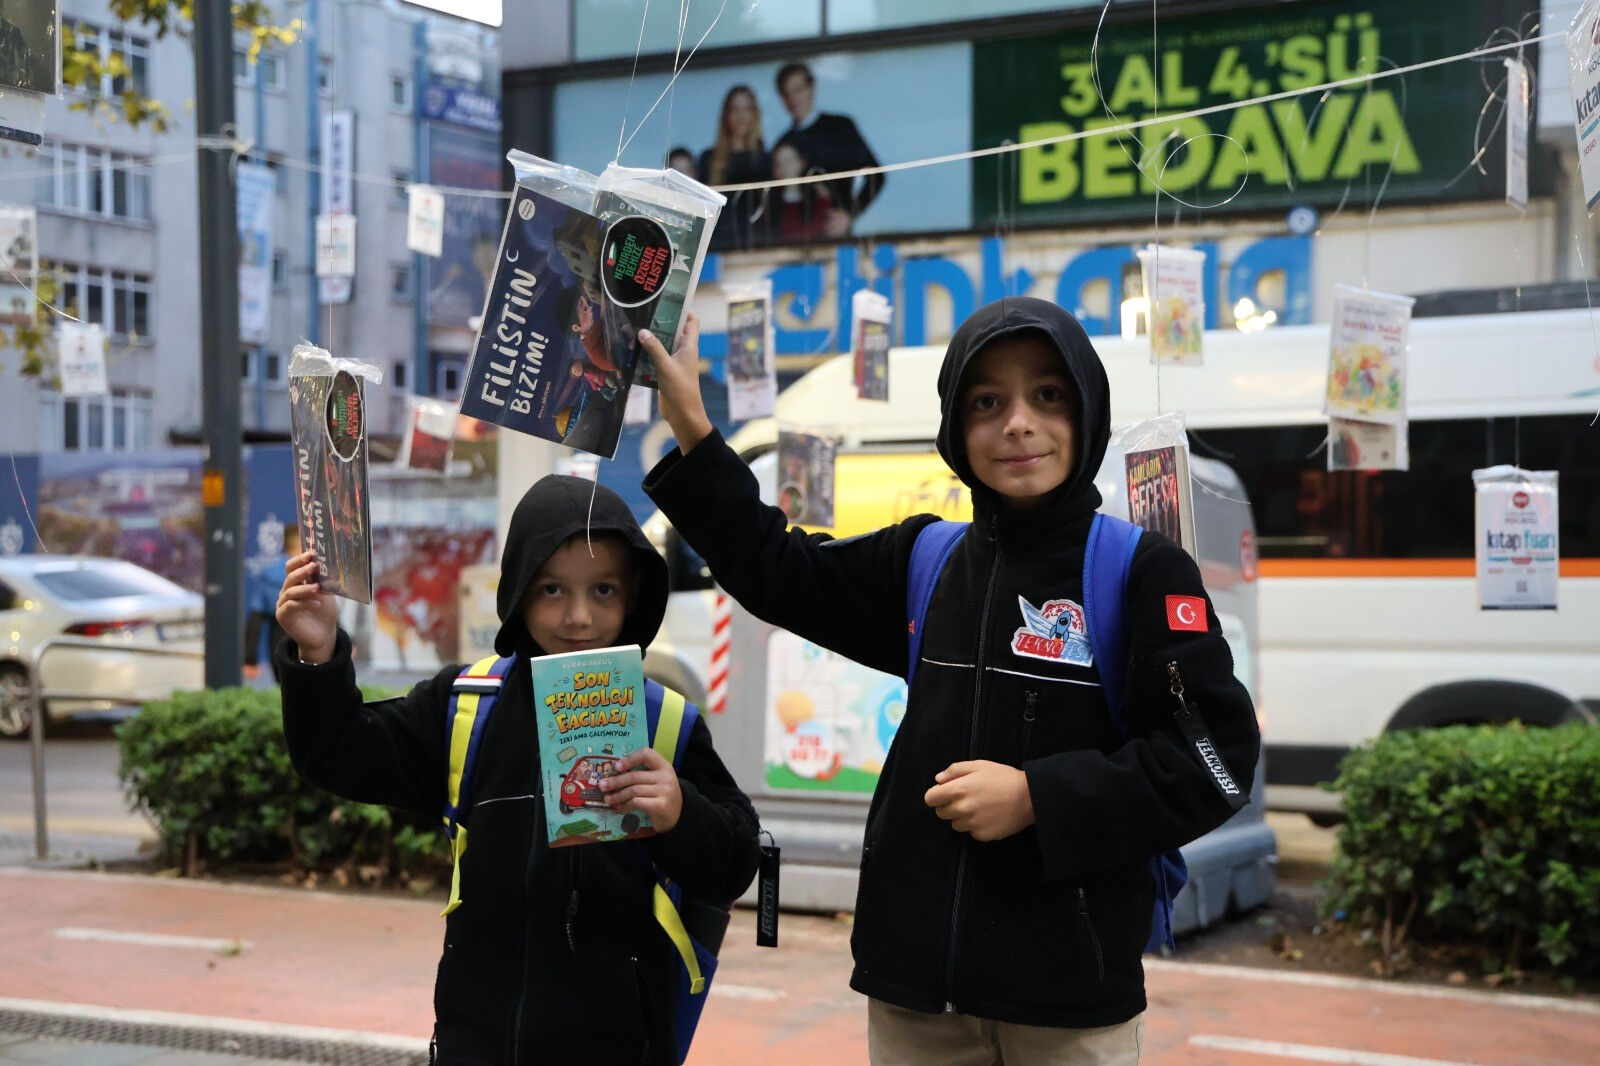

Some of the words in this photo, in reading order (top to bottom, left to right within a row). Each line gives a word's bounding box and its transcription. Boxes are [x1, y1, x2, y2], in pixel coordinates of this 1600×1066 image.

[1061, 62, 1098, 117] 3
[1109, 52, 1199, 113] AL
[1019, 90, 1421, 204] BEDAVA
[573, 672, 611, 691] SON
[545, 684, 634, 714] TEKNOLOJİ
[555, 708, 627, 734] FACİASI
[574, 732, 587, 741] AMA
[1195, 737, 1240, 795] TEKNOFEST
